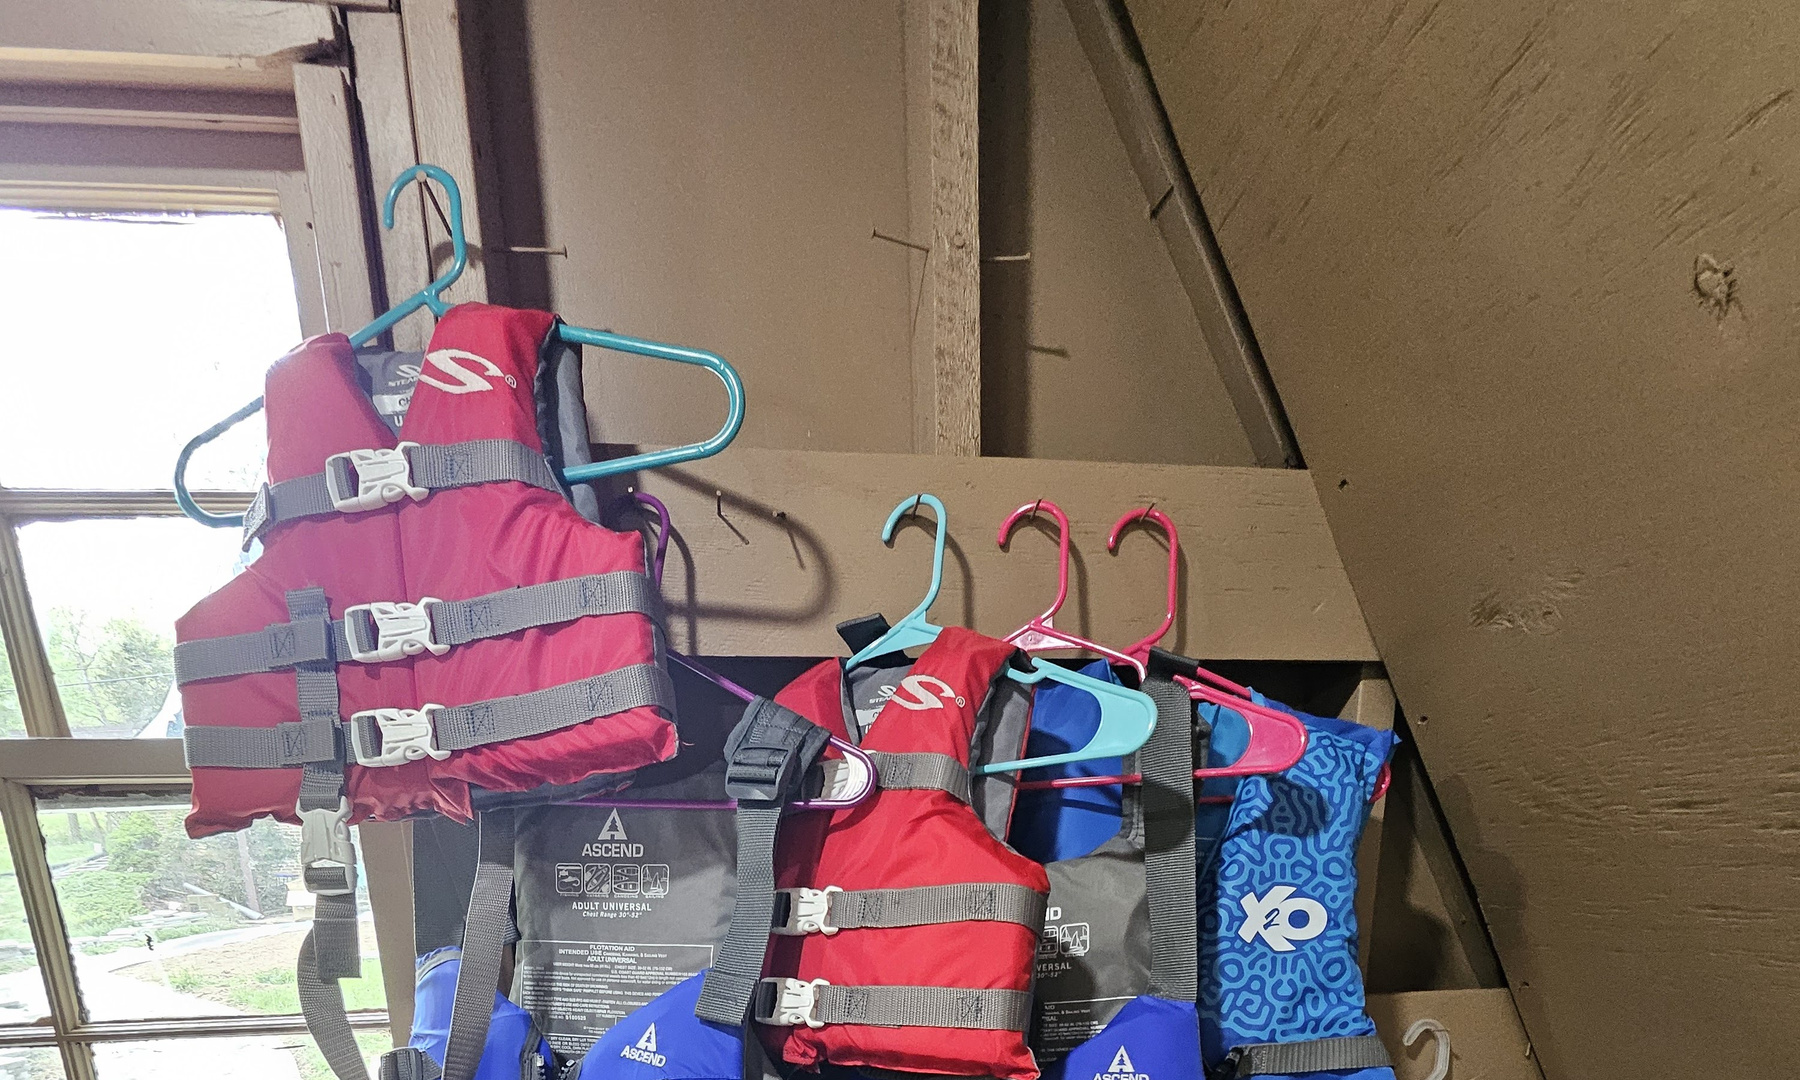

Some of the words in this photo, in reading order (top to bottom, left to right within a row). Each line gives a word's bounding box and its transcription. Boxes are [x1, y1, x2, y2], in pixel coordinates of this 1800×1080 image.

[582, 843, 644, 858] ASCEND
[572, 901, 600, 911] ADULT
[602, 902, 652, 912] UNIVERSAL
[590, 944, 623, 952] FLOTATION
[587, 955, 605, 963] ADULT
[605, 956, 637, 964] UNIVERSAL
[620, 1045, 667, 1068] ASCEND
